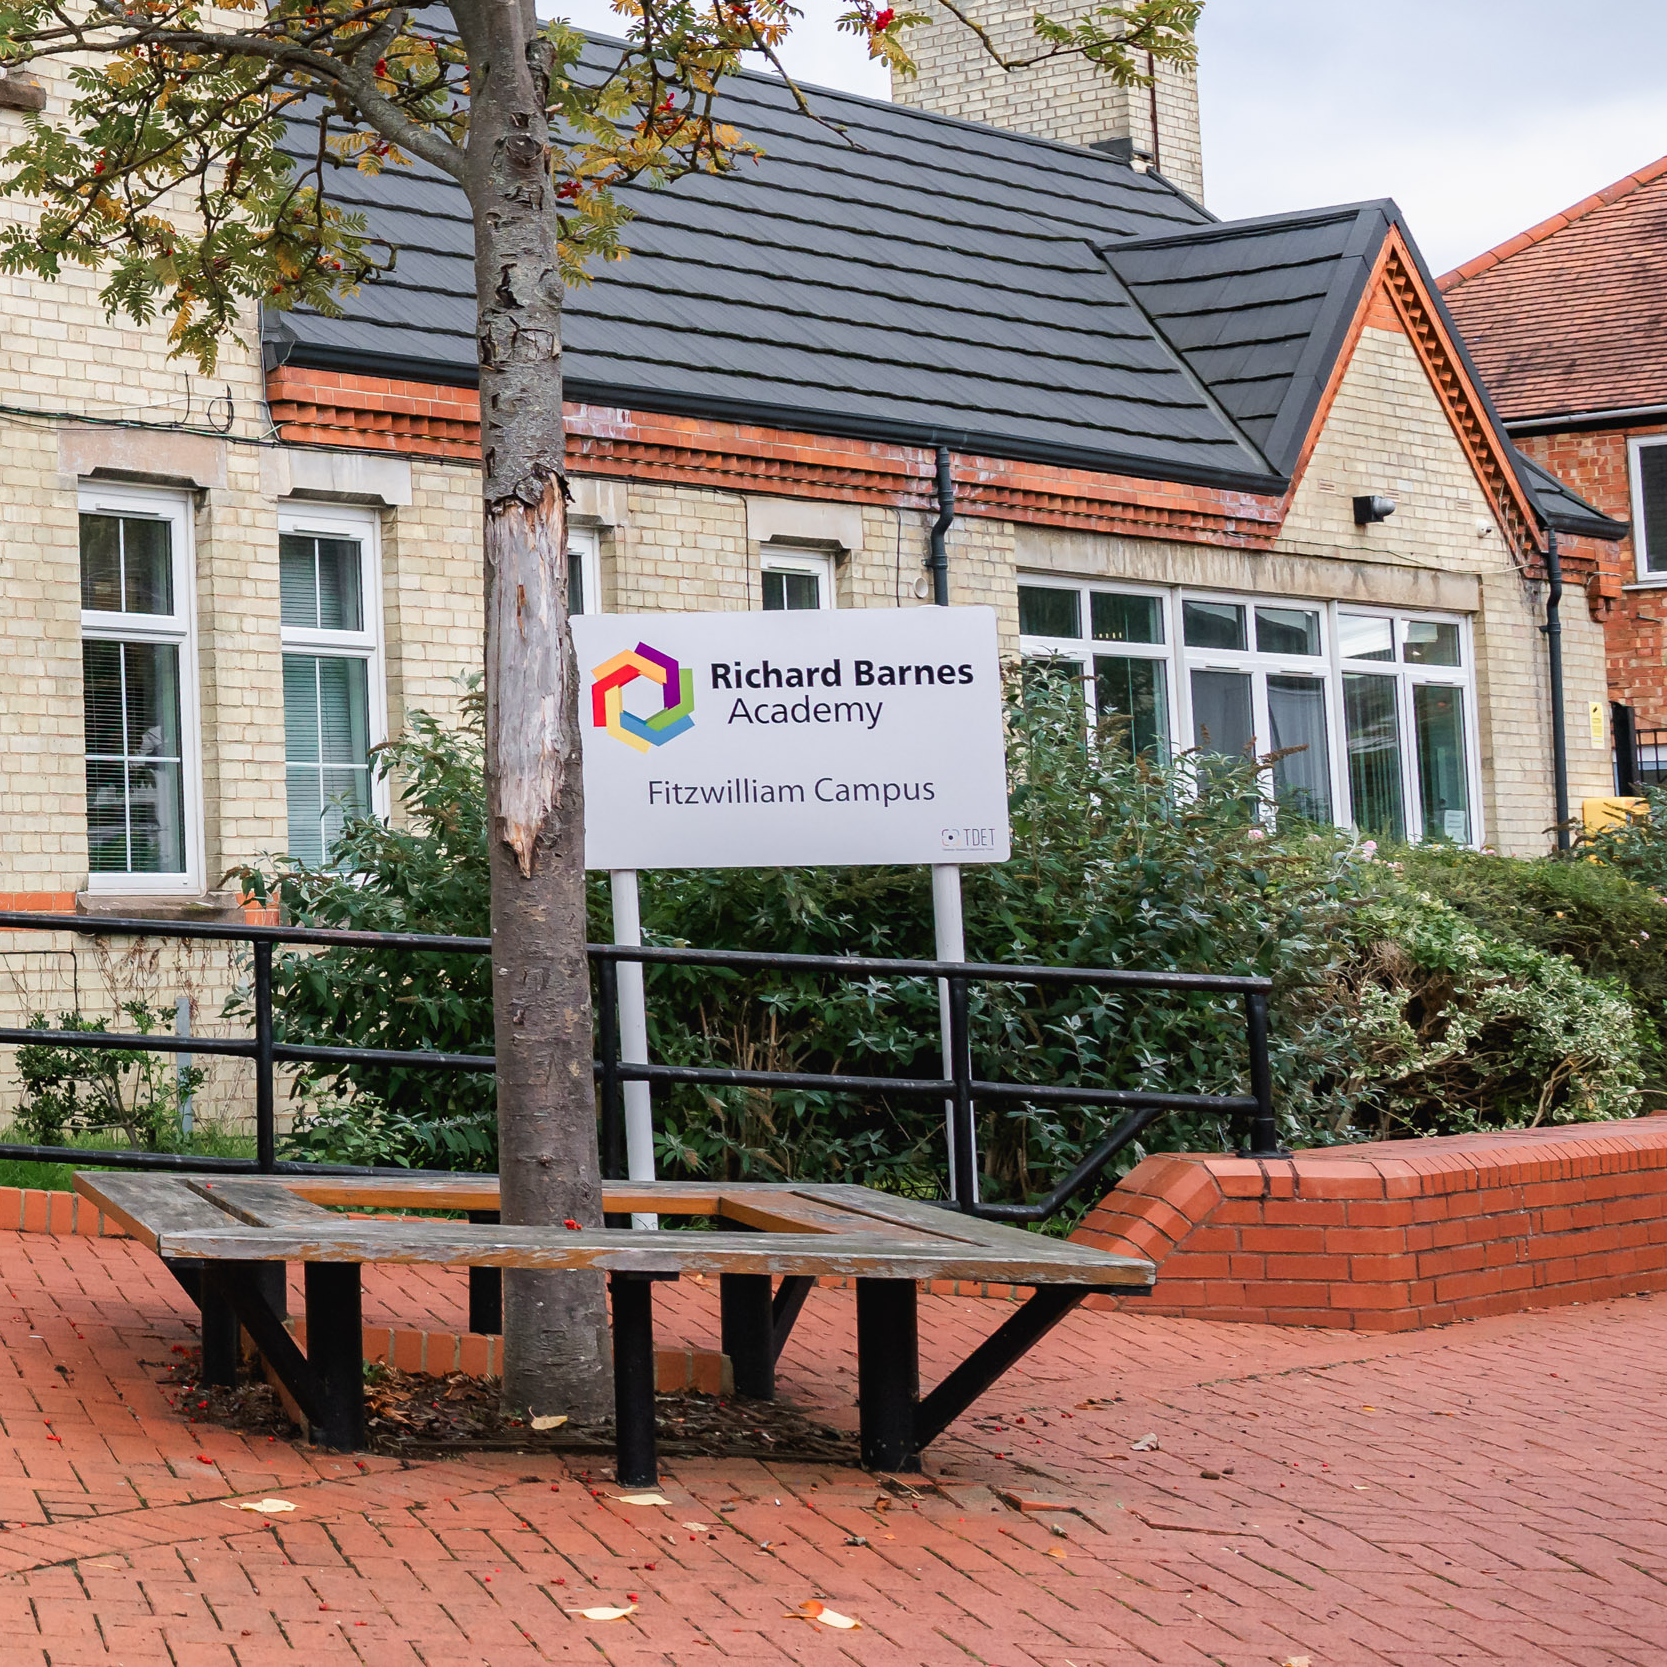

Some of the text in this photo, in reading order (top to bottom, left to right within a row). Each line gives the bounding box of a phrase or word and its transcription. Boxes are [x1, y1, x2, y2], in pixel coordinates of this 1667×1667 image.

[710, 658, 974, 690] Richard Barnes
[727, 694, 884, 730] Academy
[648, 776, 936, 808] Fitzwilliam Campus
[962, 828, 996, 846] TDET
